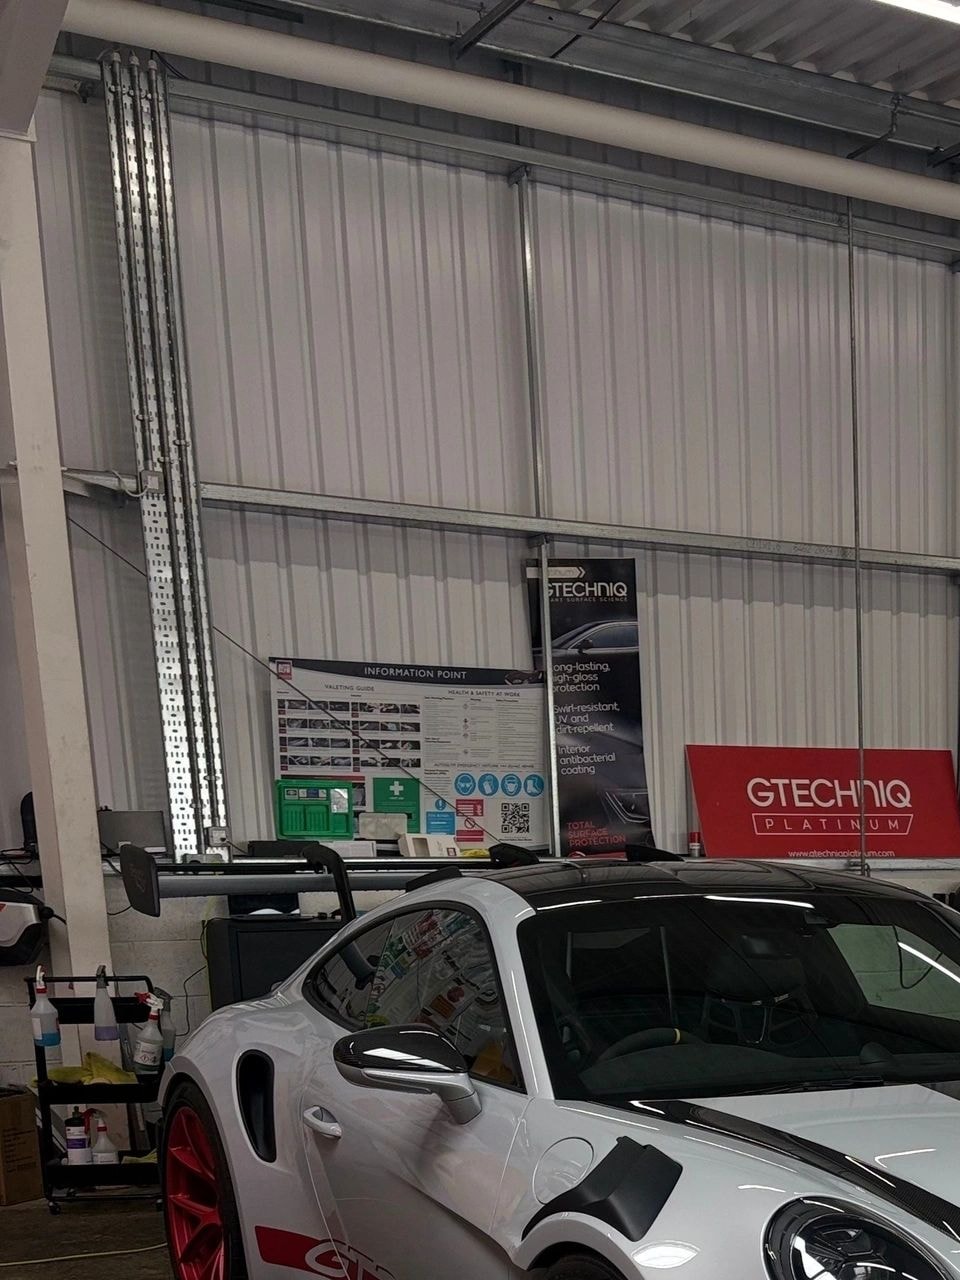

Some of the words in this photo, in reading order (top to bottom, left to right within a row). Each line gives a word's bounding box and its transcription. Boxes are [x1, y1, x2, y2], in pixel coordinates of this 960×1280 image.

[553, 661, 611, 672] ong-lasting,
[364, 667, 434, 678] INFORMATION
[437, 670, 467, 679] POINT
[554, 673, 599, 684] igh-gloss
[570, 713, 589, 723] and
[560, 752, 616, 764] antibacterial
[561, 765, 596, 775] coating
[746, 777, 913, 808] GTECHNIQ
[567, 821, 595, 830] TOTAL
[765, 818, 900, 830] PLATINUM
[568, 827, 609, 838] SURFACE
[569, 835, 626, 847] PROTECTION
